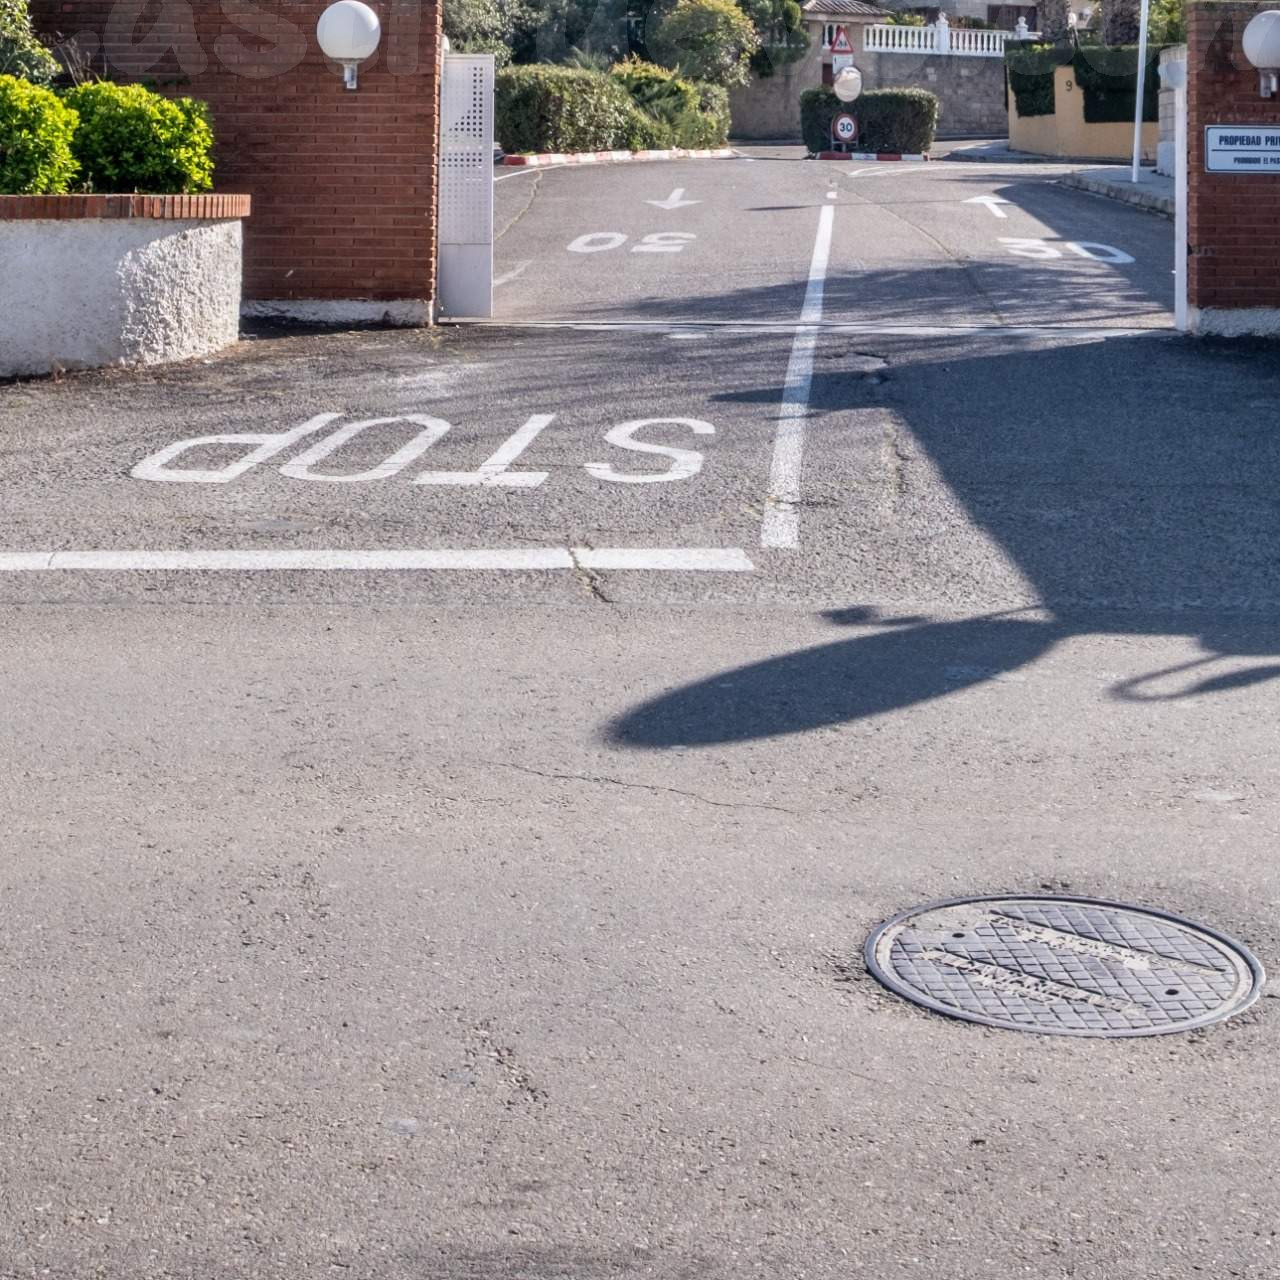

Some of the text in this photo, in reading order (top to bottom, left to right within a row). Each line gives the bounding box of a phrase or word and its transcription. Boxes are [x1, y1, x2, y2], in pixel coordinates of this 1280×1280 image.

[1065, 79, 1073, 92] 9
[839, 122, 853, 133] 30
[1218, 135, 1262, 146] PROPIEDAD
[996, 237, 1137, 264] 30
[130, 411, 717, 488] STOP
